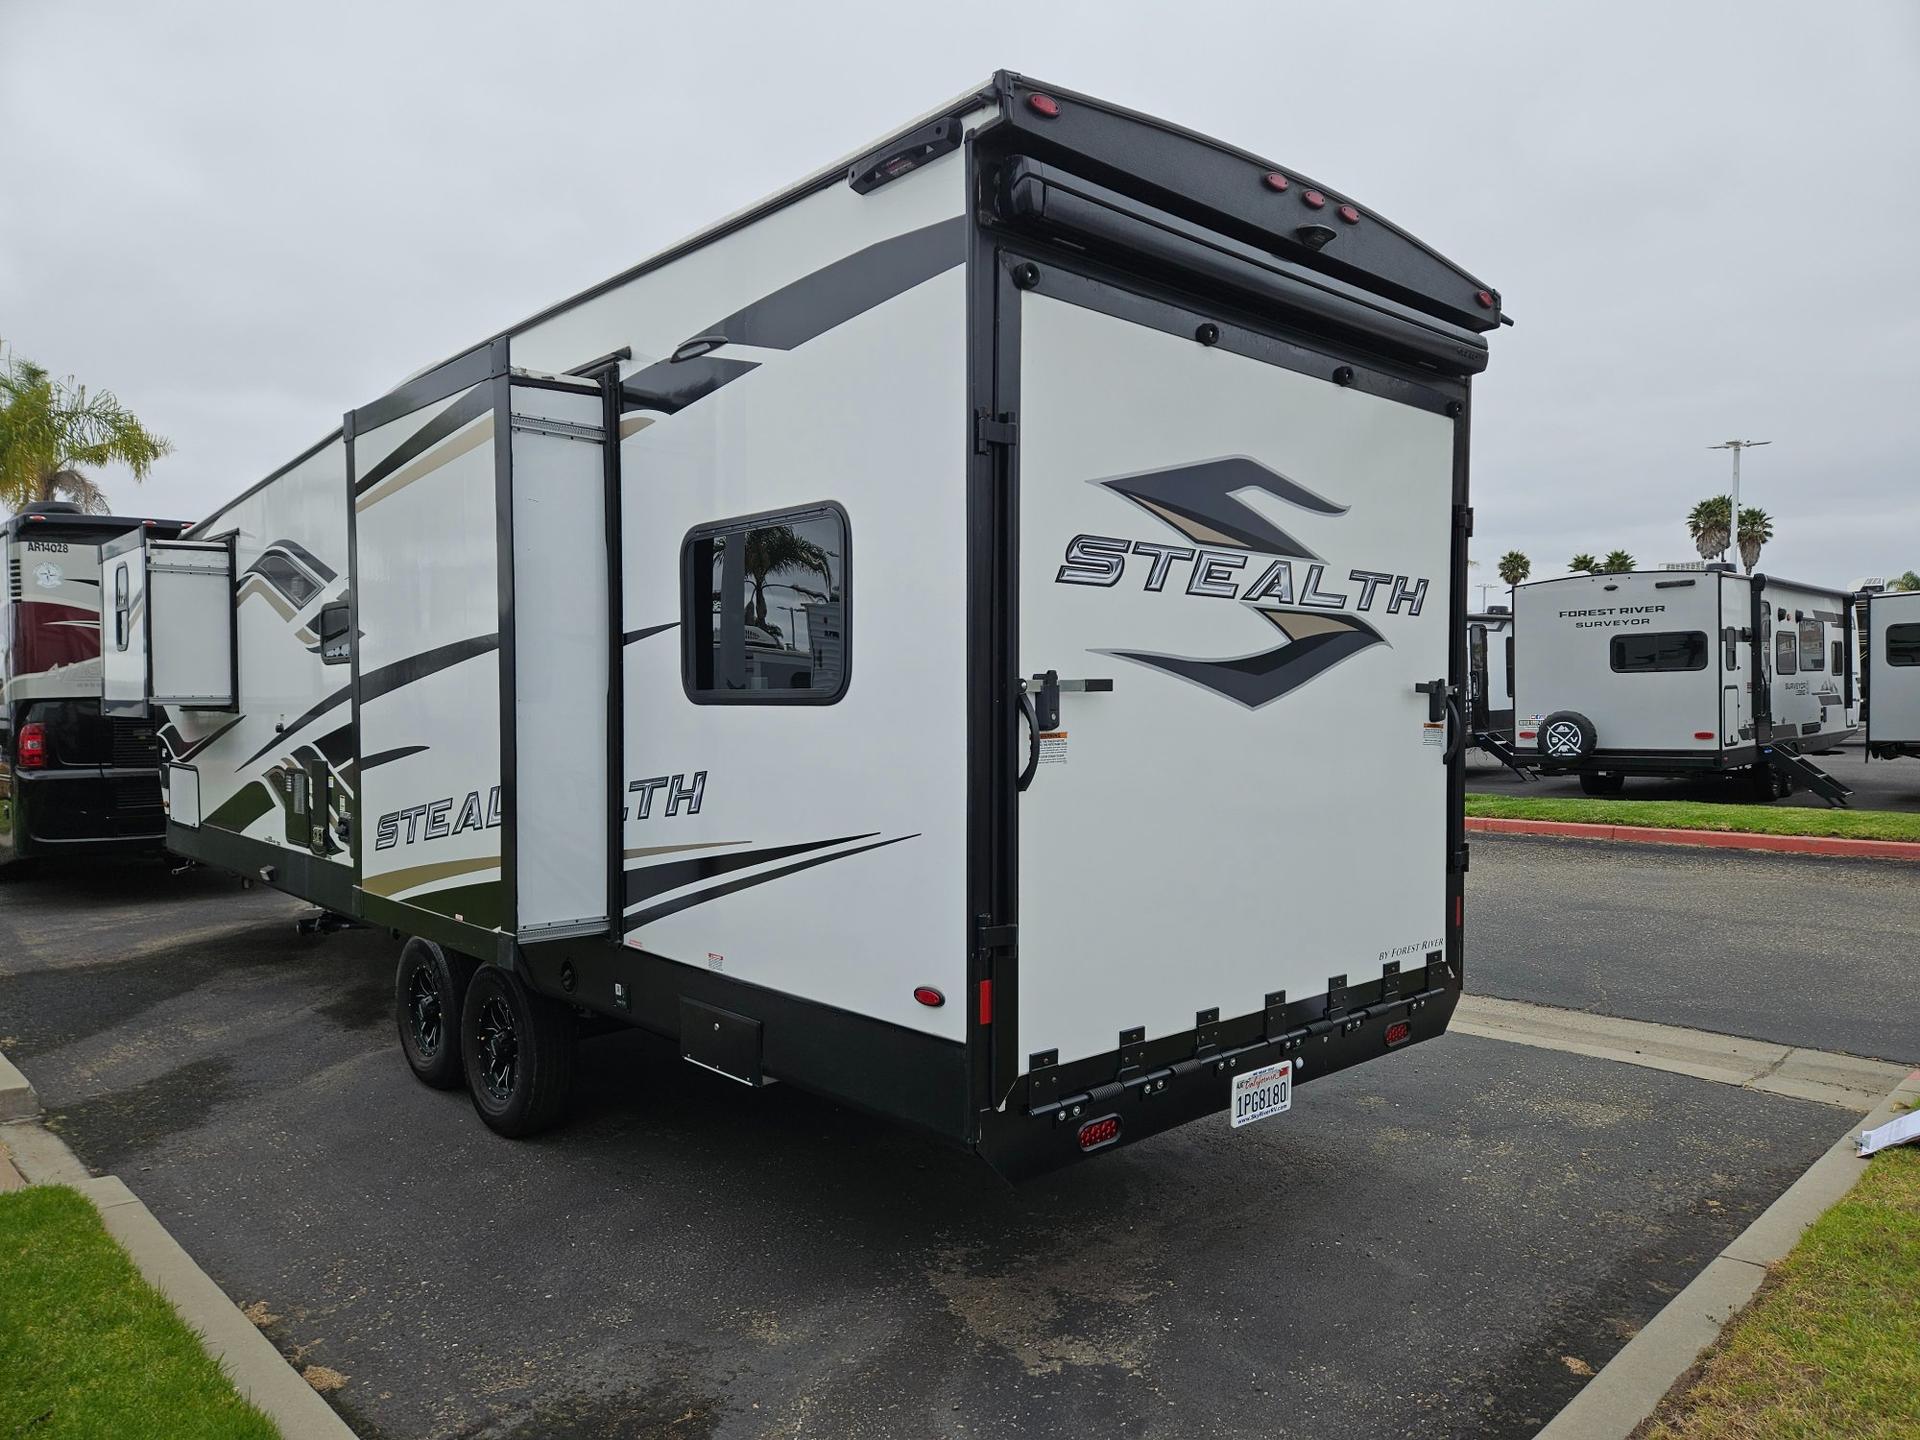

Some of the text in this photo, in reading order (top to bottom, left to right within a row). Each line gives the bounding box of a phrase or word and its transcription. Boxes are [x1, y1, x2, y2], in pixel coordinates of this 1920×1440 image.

[27, 542, 69, 553] AR14028
[1055, 533, 1430, 616] STEALTH
[1559, 605, 1666, 618] FOREST RIVER
[1575, 618, 1650, 628] SURVEYOR
[1391, 943, 1420, 957] FOREST
[1421, 938, 1444, 950] RIVER
[1236, 1081, 1287, 1118] 1PG8180
[1237, 1104, 1288, 1125] www.SkyRiverRV.com
